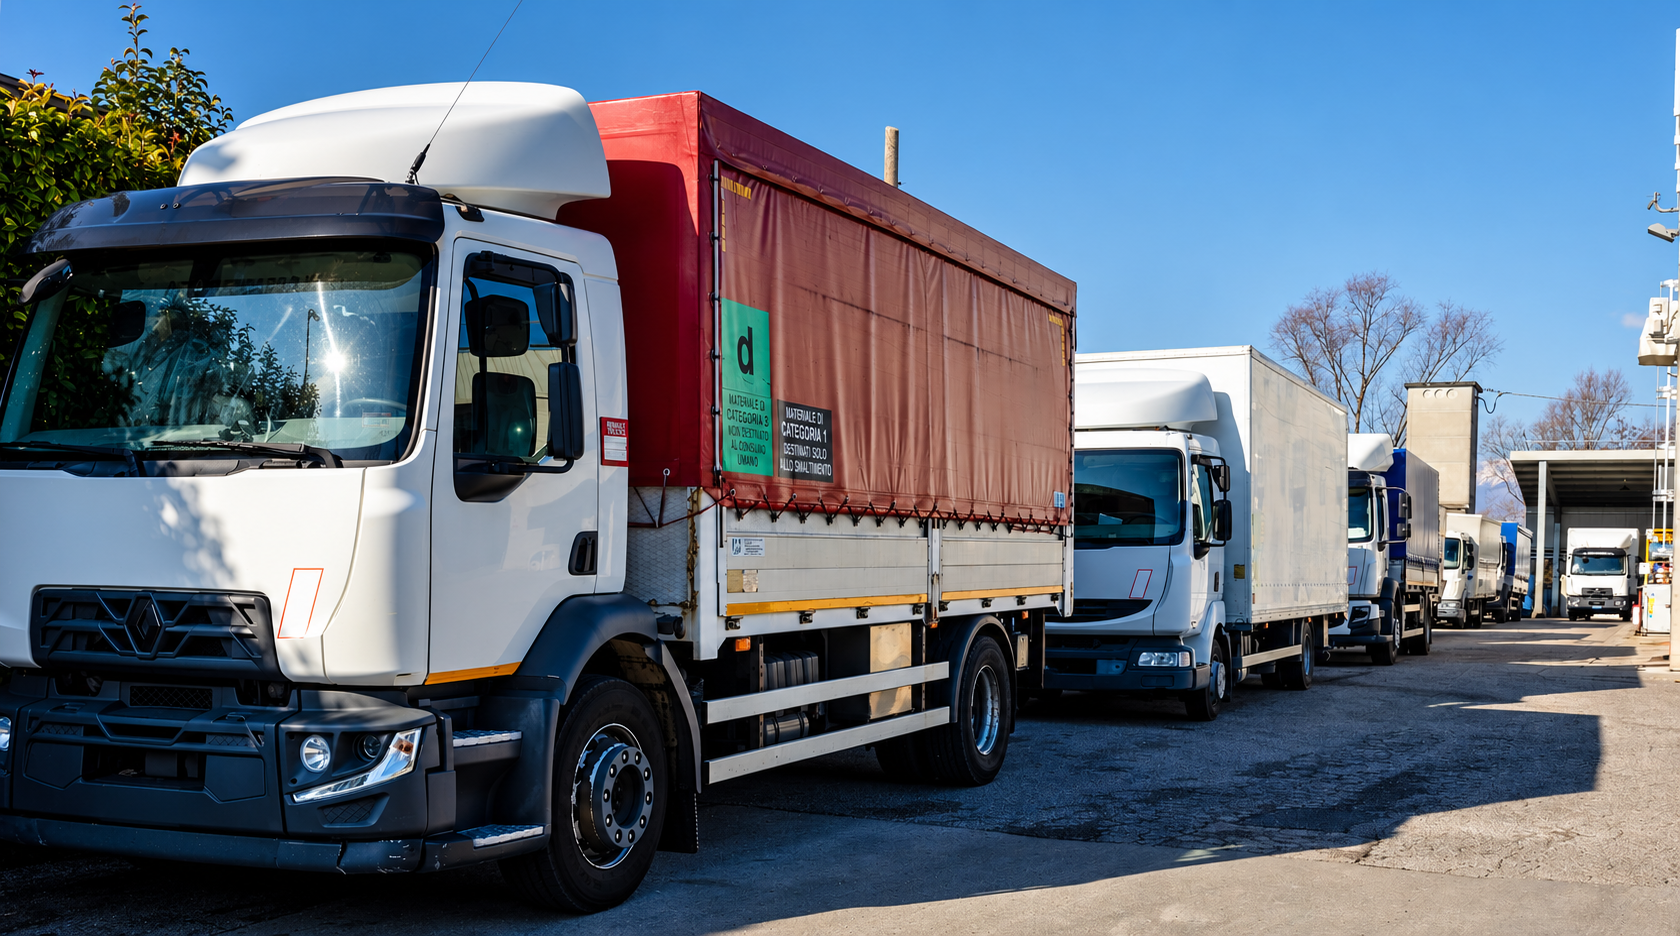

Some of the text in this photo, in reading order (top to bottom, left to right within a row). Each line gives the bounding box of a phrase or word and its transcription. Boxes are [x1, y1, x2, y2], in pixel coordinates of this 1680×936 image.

[737, 326, 754, 375] d
[727, 408, 769, 427] CATEGORIA 3
[817, 412, 823, 425] DI
[781, 420, 827, 443] CATEGORIA 1
[812, 447, 827, 460] SOLO
